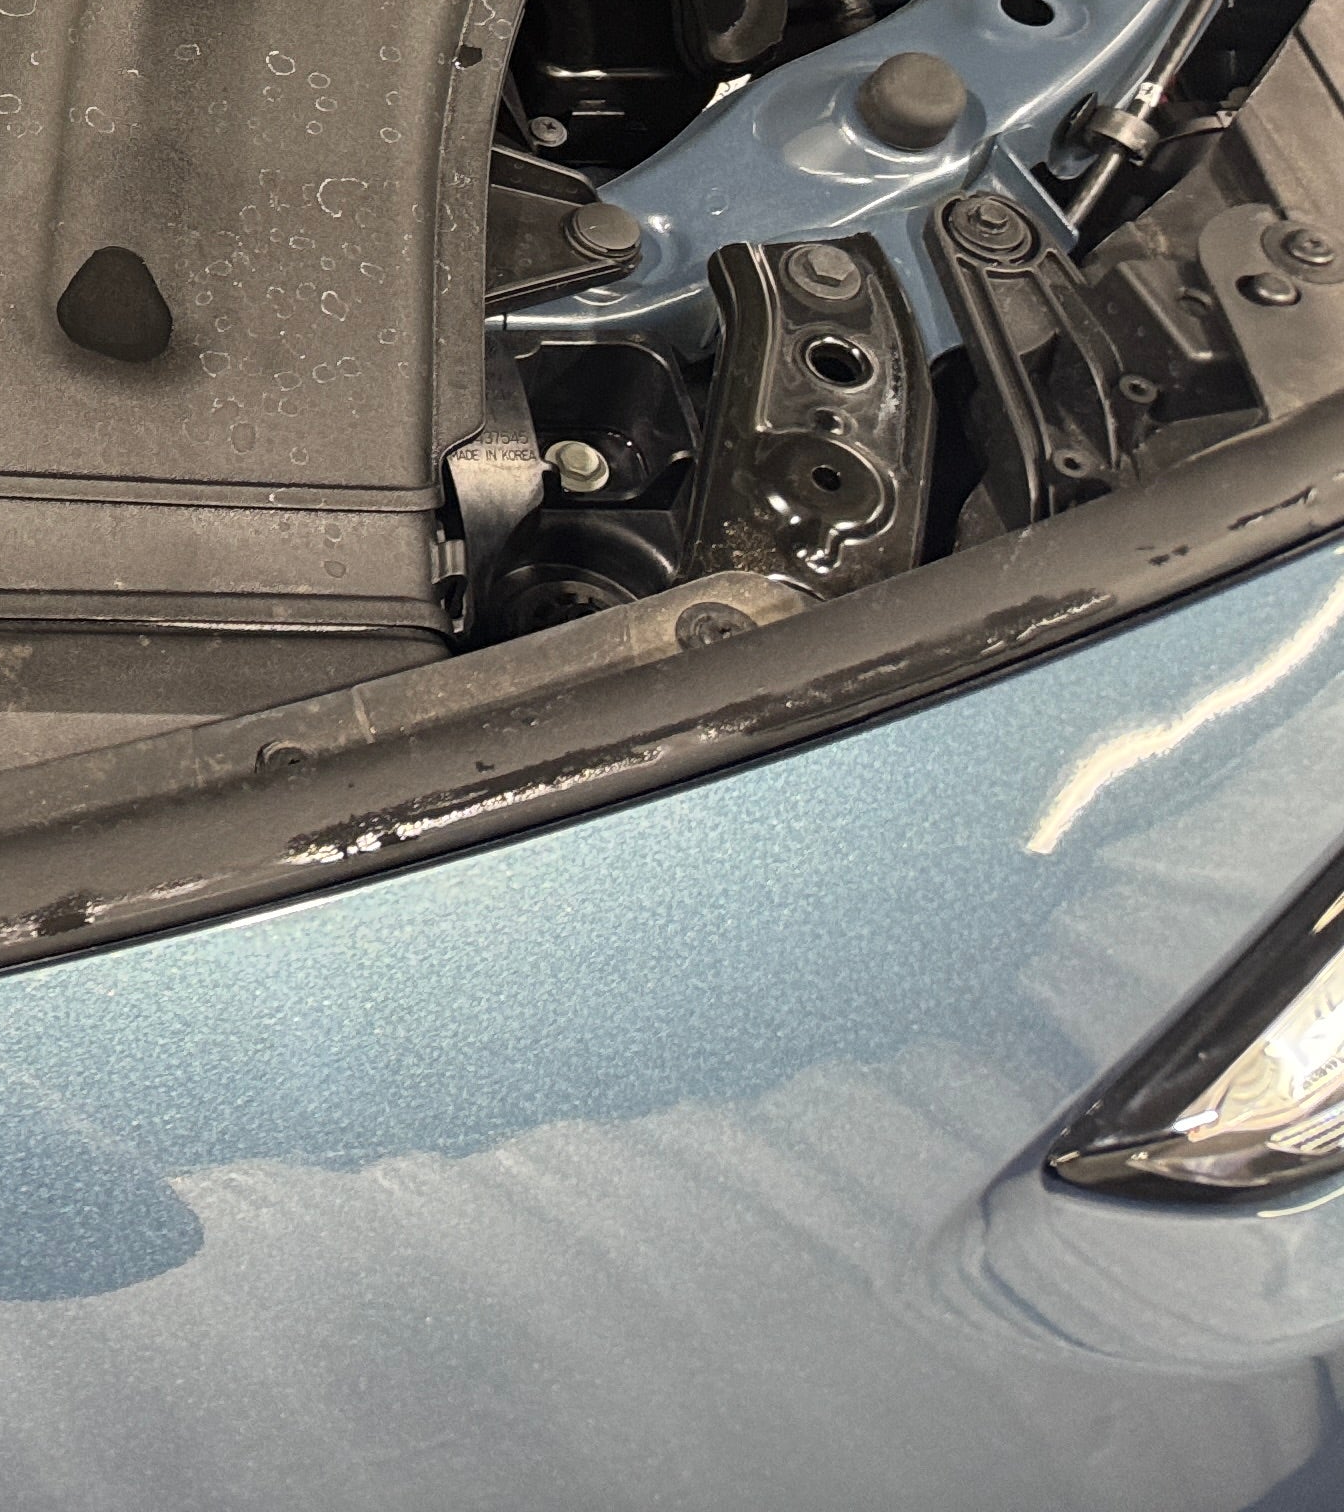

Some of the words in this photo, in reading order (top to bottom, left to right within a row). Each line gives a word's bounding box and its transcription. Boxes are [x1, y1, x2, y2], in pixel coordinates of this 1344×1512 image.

[452, 450, 480, 461] MADE
[486, 450, 497, 461] IN
[502, 450, 537, 461] KOREA
